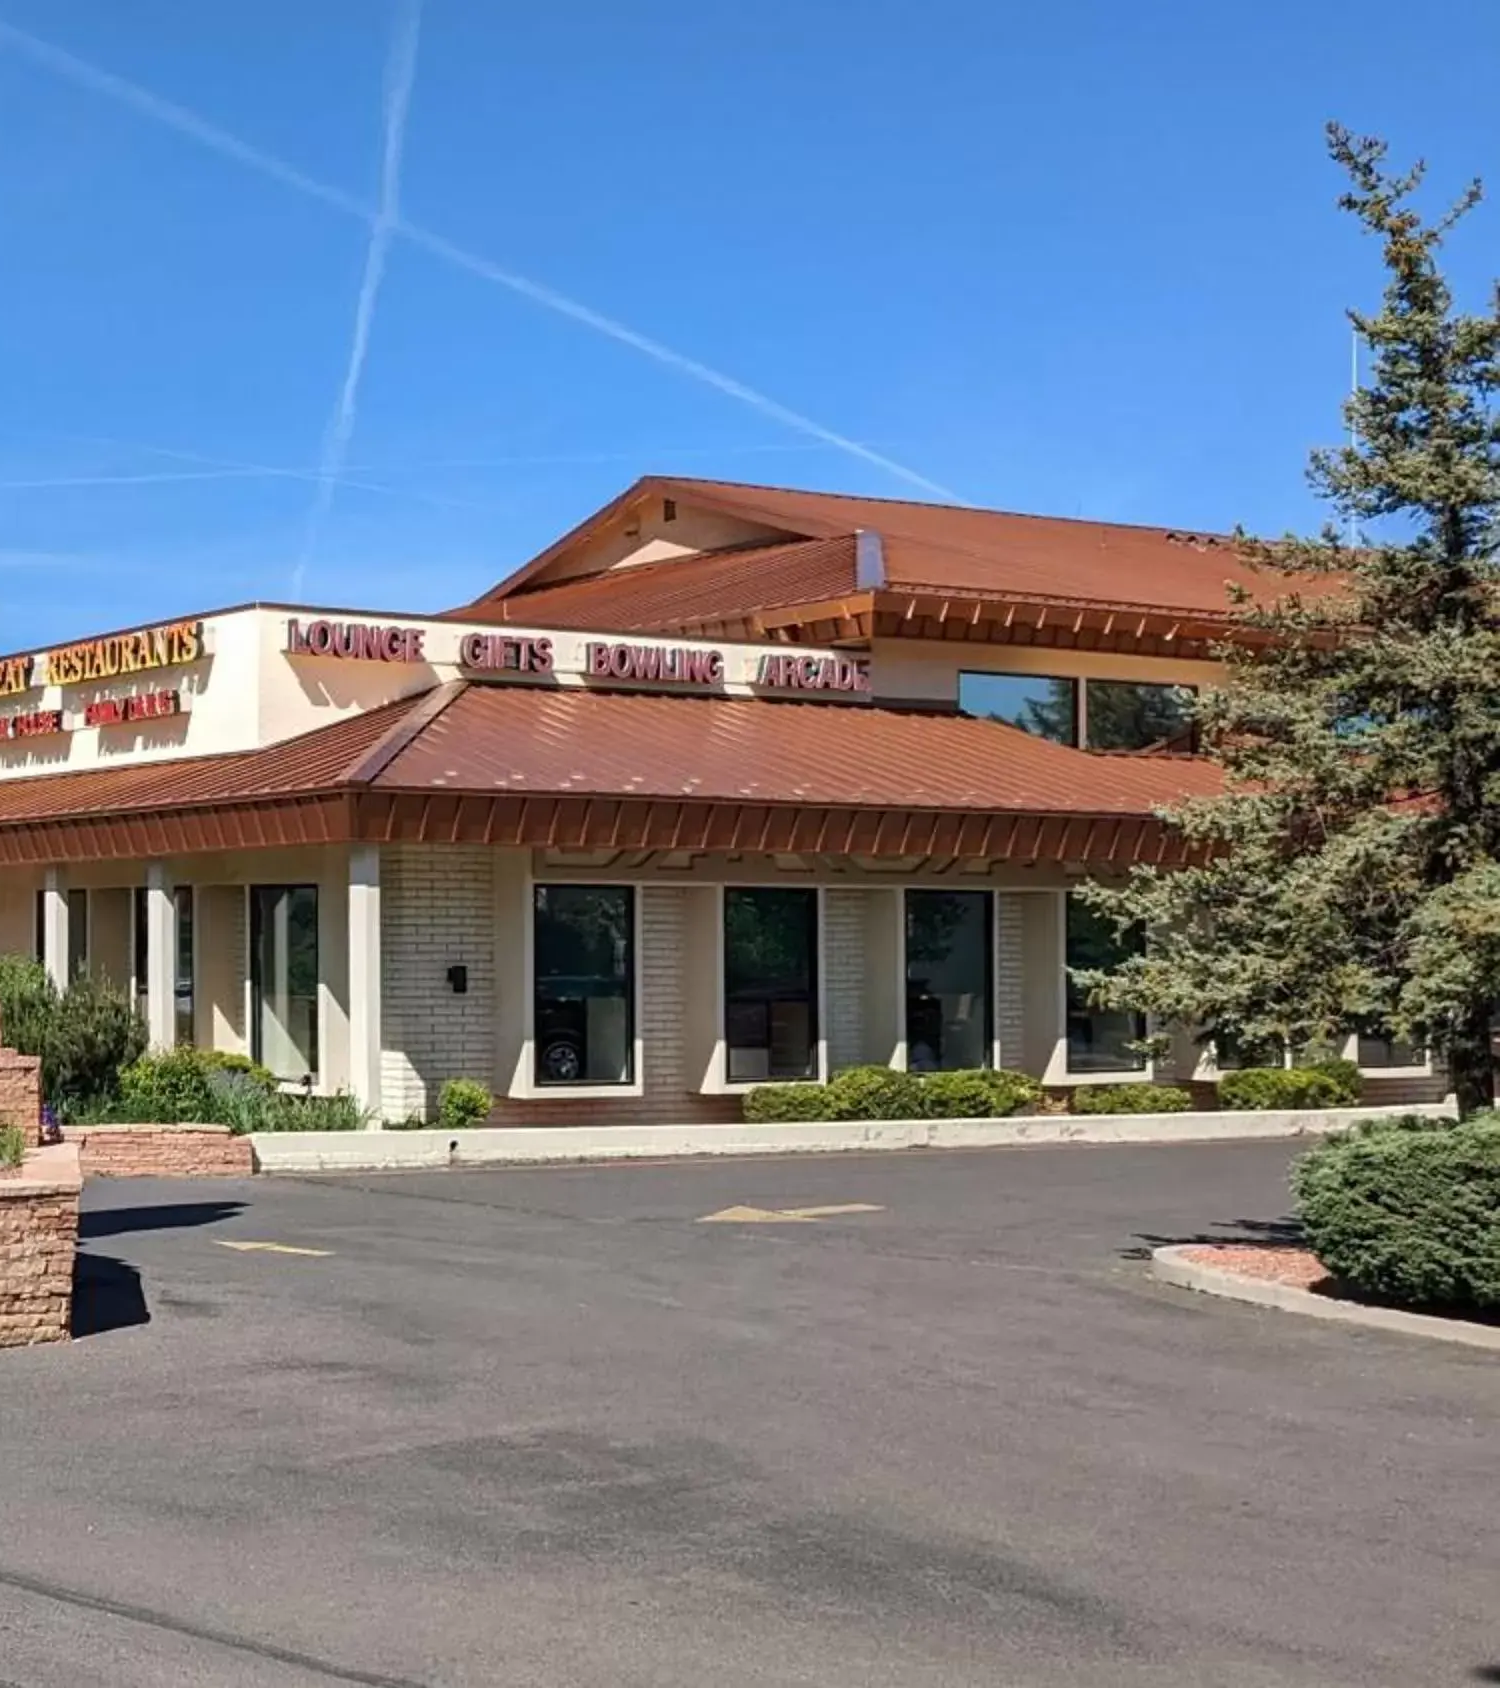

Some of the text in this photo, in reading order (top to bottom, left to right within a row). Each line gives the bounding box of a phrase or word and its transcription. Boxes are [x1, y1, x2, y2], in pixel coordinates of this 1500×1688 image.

[44, 621, 202, 686] RESTAURANTS
[286, 618, 871, 692] LOUNGE GIFTS BOWLING ARCADE
